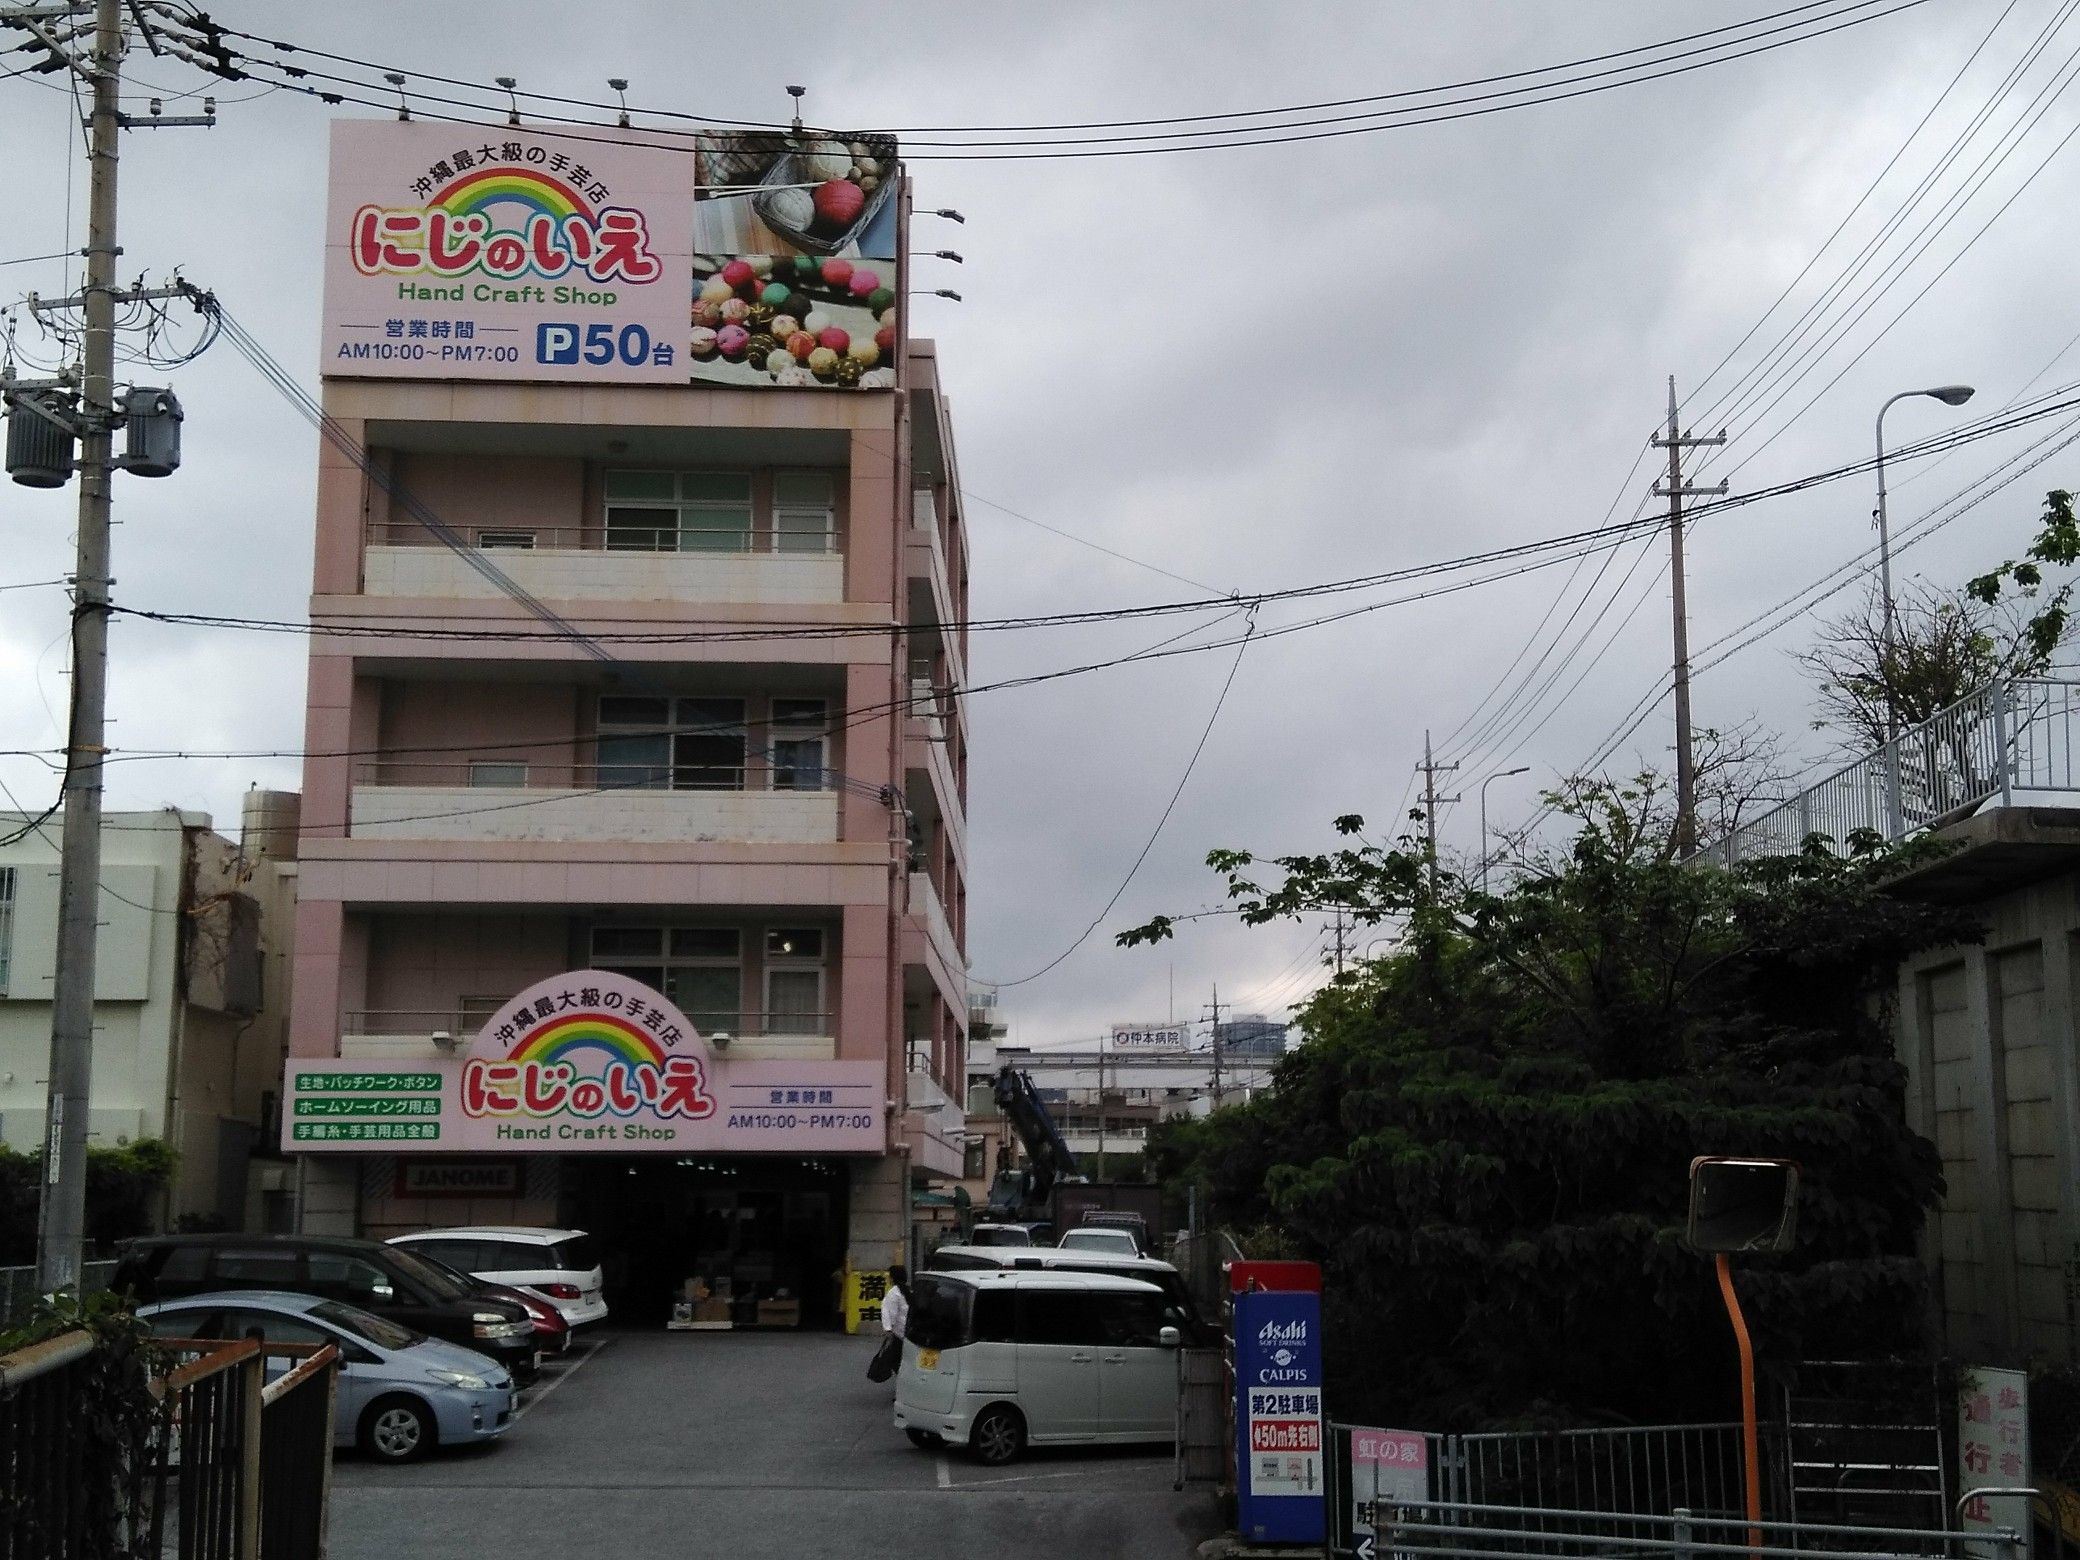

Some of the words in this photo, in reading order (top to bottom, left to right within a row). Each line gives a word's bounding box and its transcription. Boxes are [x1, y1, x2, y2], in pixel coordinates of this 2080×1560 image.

[408, 141, 612, 206] 沖縄最大級の手芸店
[352, 206, 661, 284] にじのいえ
[399, 282, 465, 302] Hand
[473, 284, 547, 303] Craft
[554, 286, 618, 306] Shop
[386, 319, 474, 340] 営業時間
[494, 988, 682, 1048] 沖縄最大級の手芸店
[1130, 1031, 1180, 1046] 仲本病院
[463, 1061, 713, 1118] にじのいえ
[769, 1090, 833, 1104] 営業時間
[298, 1100, 437, 1114] ホームソーイング用品
[496, 1124, 551, 1140] Hand
[557, 1124, 617, 1140] Craft
[624, 1124, 676, 1142] Shop
[414, 1168, 510, 1187] JANOME
[1259, 1320, 1307, 1340] Asahi
[1260, 1368, 1308, 1383] CALPIS
[1252, 1394, 1319, 1415] 第2駐車場
[1358, 1438, 1419, 1463] 虹の家
